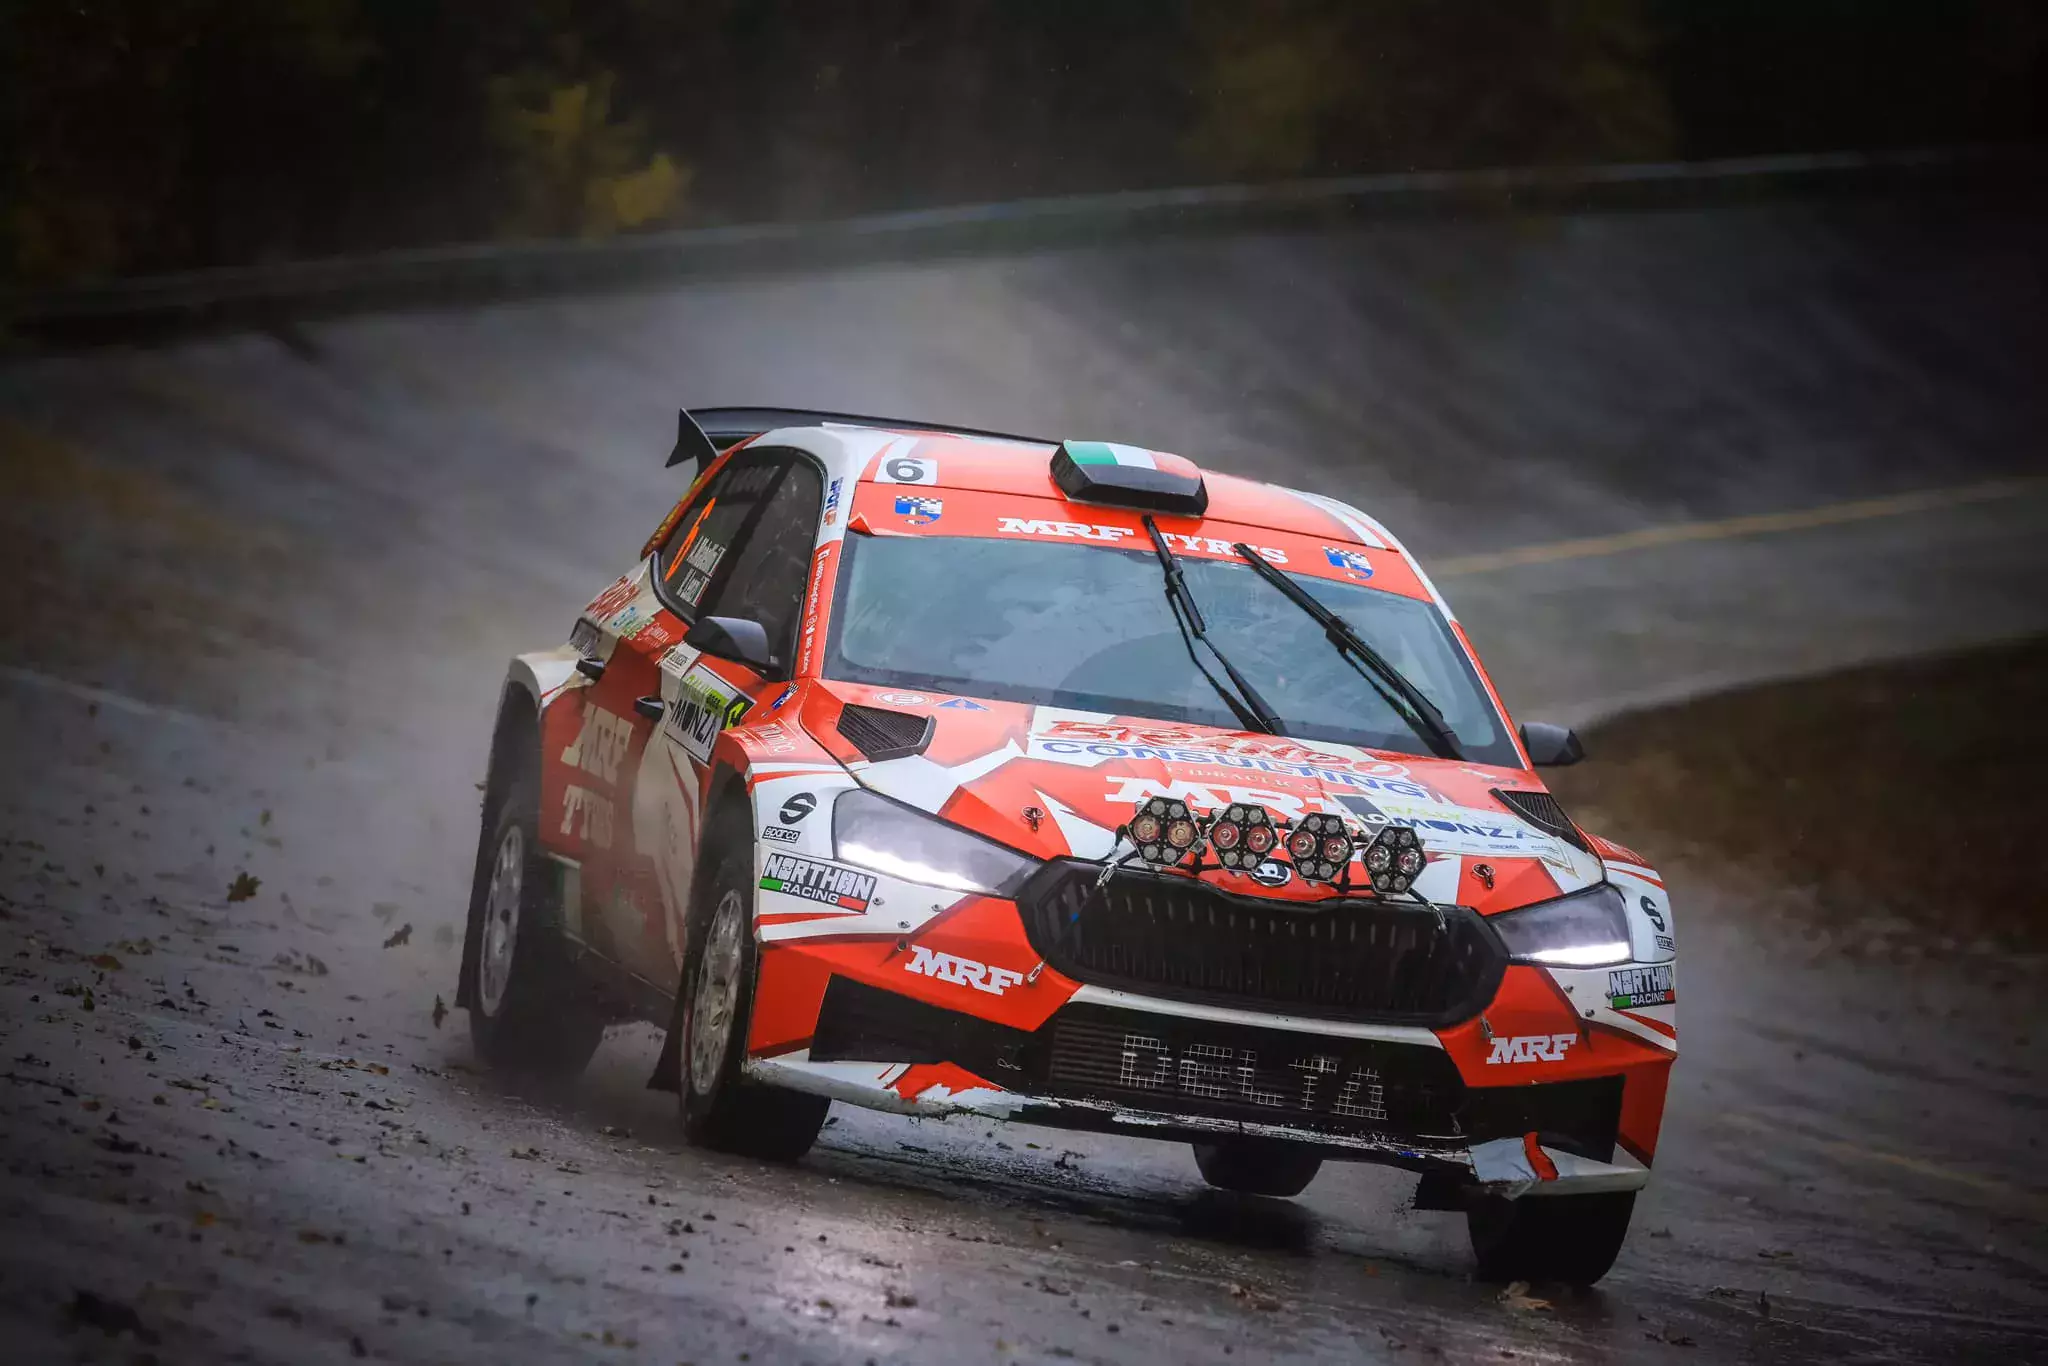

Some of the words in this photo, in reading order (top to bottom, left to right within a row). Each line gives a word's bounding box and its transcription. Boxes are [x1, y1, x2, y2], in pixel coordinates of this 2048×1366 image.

[886, 458, 925, 482] 6
[997, 517, 1135, 542] MRF
[1041, 741, 1427, 799] CONSULTING
[762, 853, 876, 900] NORTHON
[780, 881, 840, 904] RACING
[903, 944, 1024, 996] MRF
[1630, 989, 1665, 1006] RACING
[1486, 1033, 1578, 1065] MRF
[1119, 1033, 1389, 1121] DELTA
